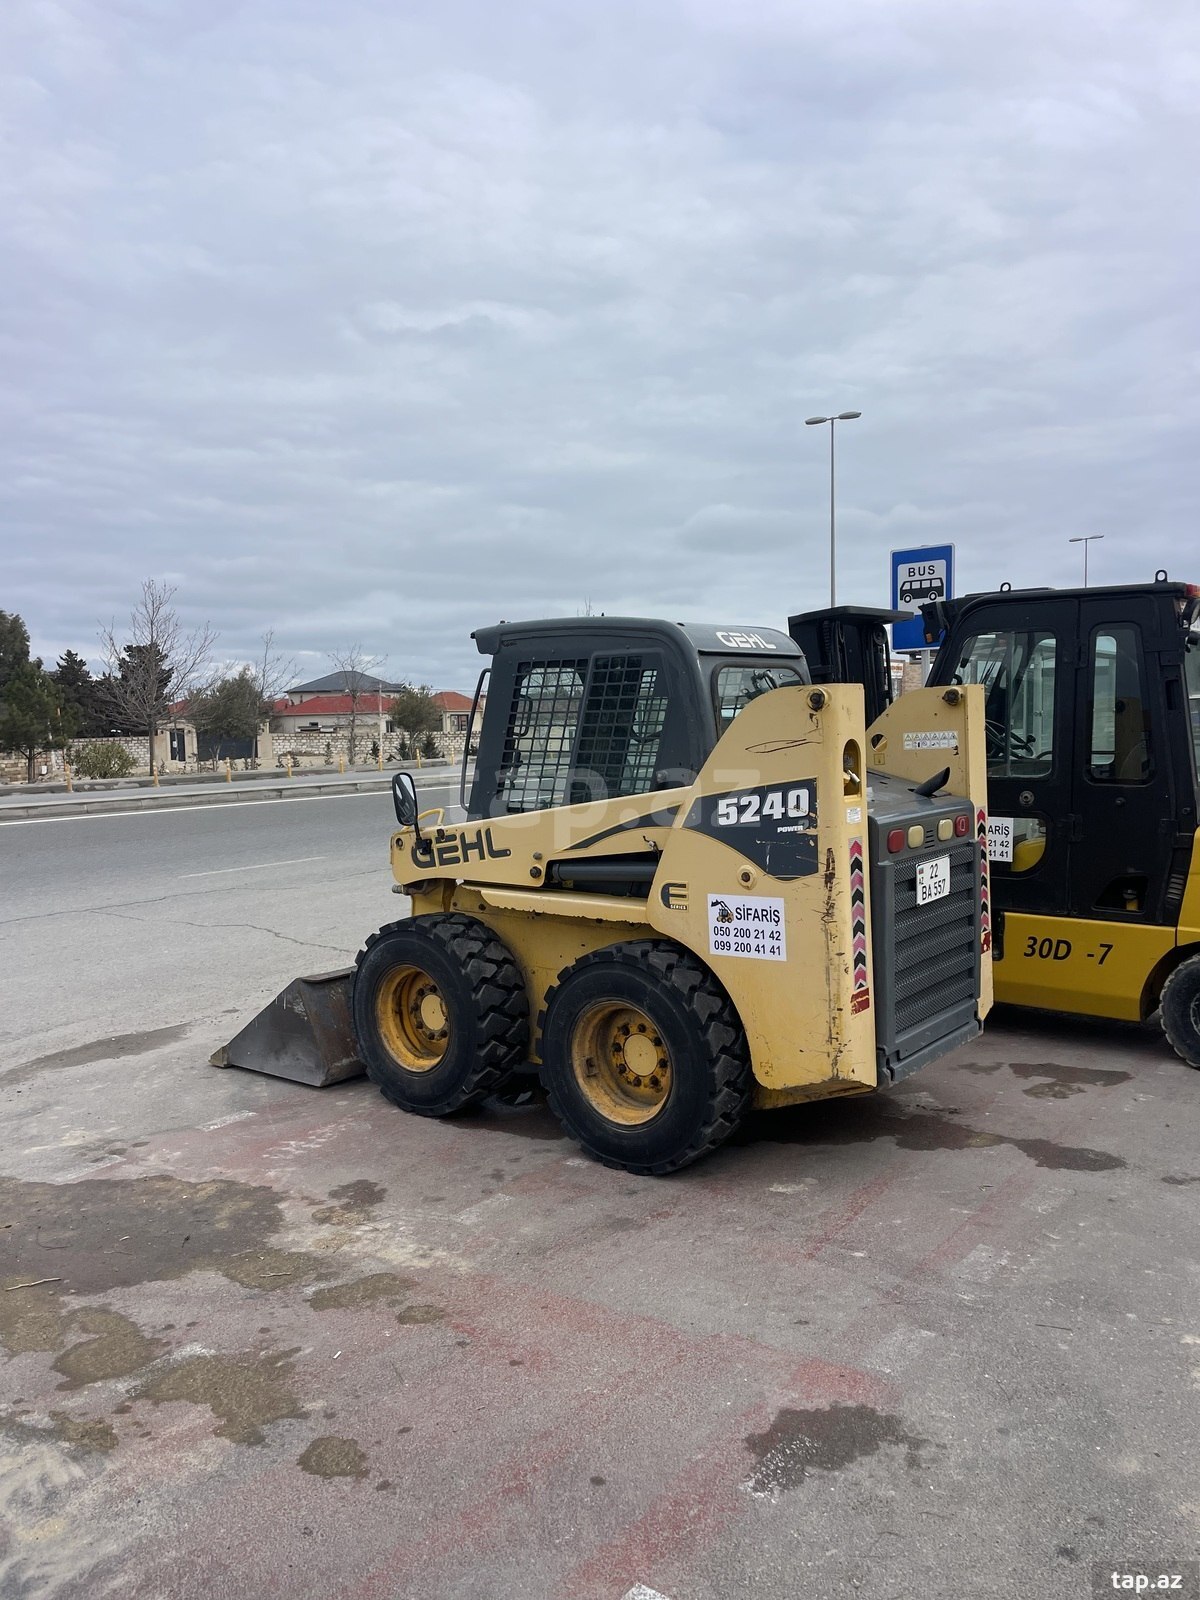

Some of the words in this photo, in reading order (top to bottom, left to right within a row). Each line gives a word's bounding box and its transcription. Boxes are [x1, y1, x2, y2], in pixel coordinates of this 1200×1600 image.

[908, 565, 936, 578] BUS
[715, 631, 777, 649] GEHL
[718, 789, 809, 826] 5240
[988, 823, 1010, 839] ARİŞ
[411, 827, 512, 869] GEHL
[999, 840, 1010, 849] 42
[999, 850, 1009, 859] 41
[930, 863, 939, 879] 22
[921, 884, 932, 901] BA
[933, 878, 946, 896] 557
[735, 904, 781, 926] SİFARİŞ
[713, 925, 731, 937] 050
[733, 927, 751, 939] 200
[753, 929, 765, 940] 21
[768, 930, 781, 941] 42
[714, 939, 731, 951] 099
[734, 941, 752, 953] 200
[754, 943, 766, 954] 41
[769, 945, 781, 956] 41
[1023, 936, 1072, 961] 30D
[1086, 943, 1114, 965] -7
